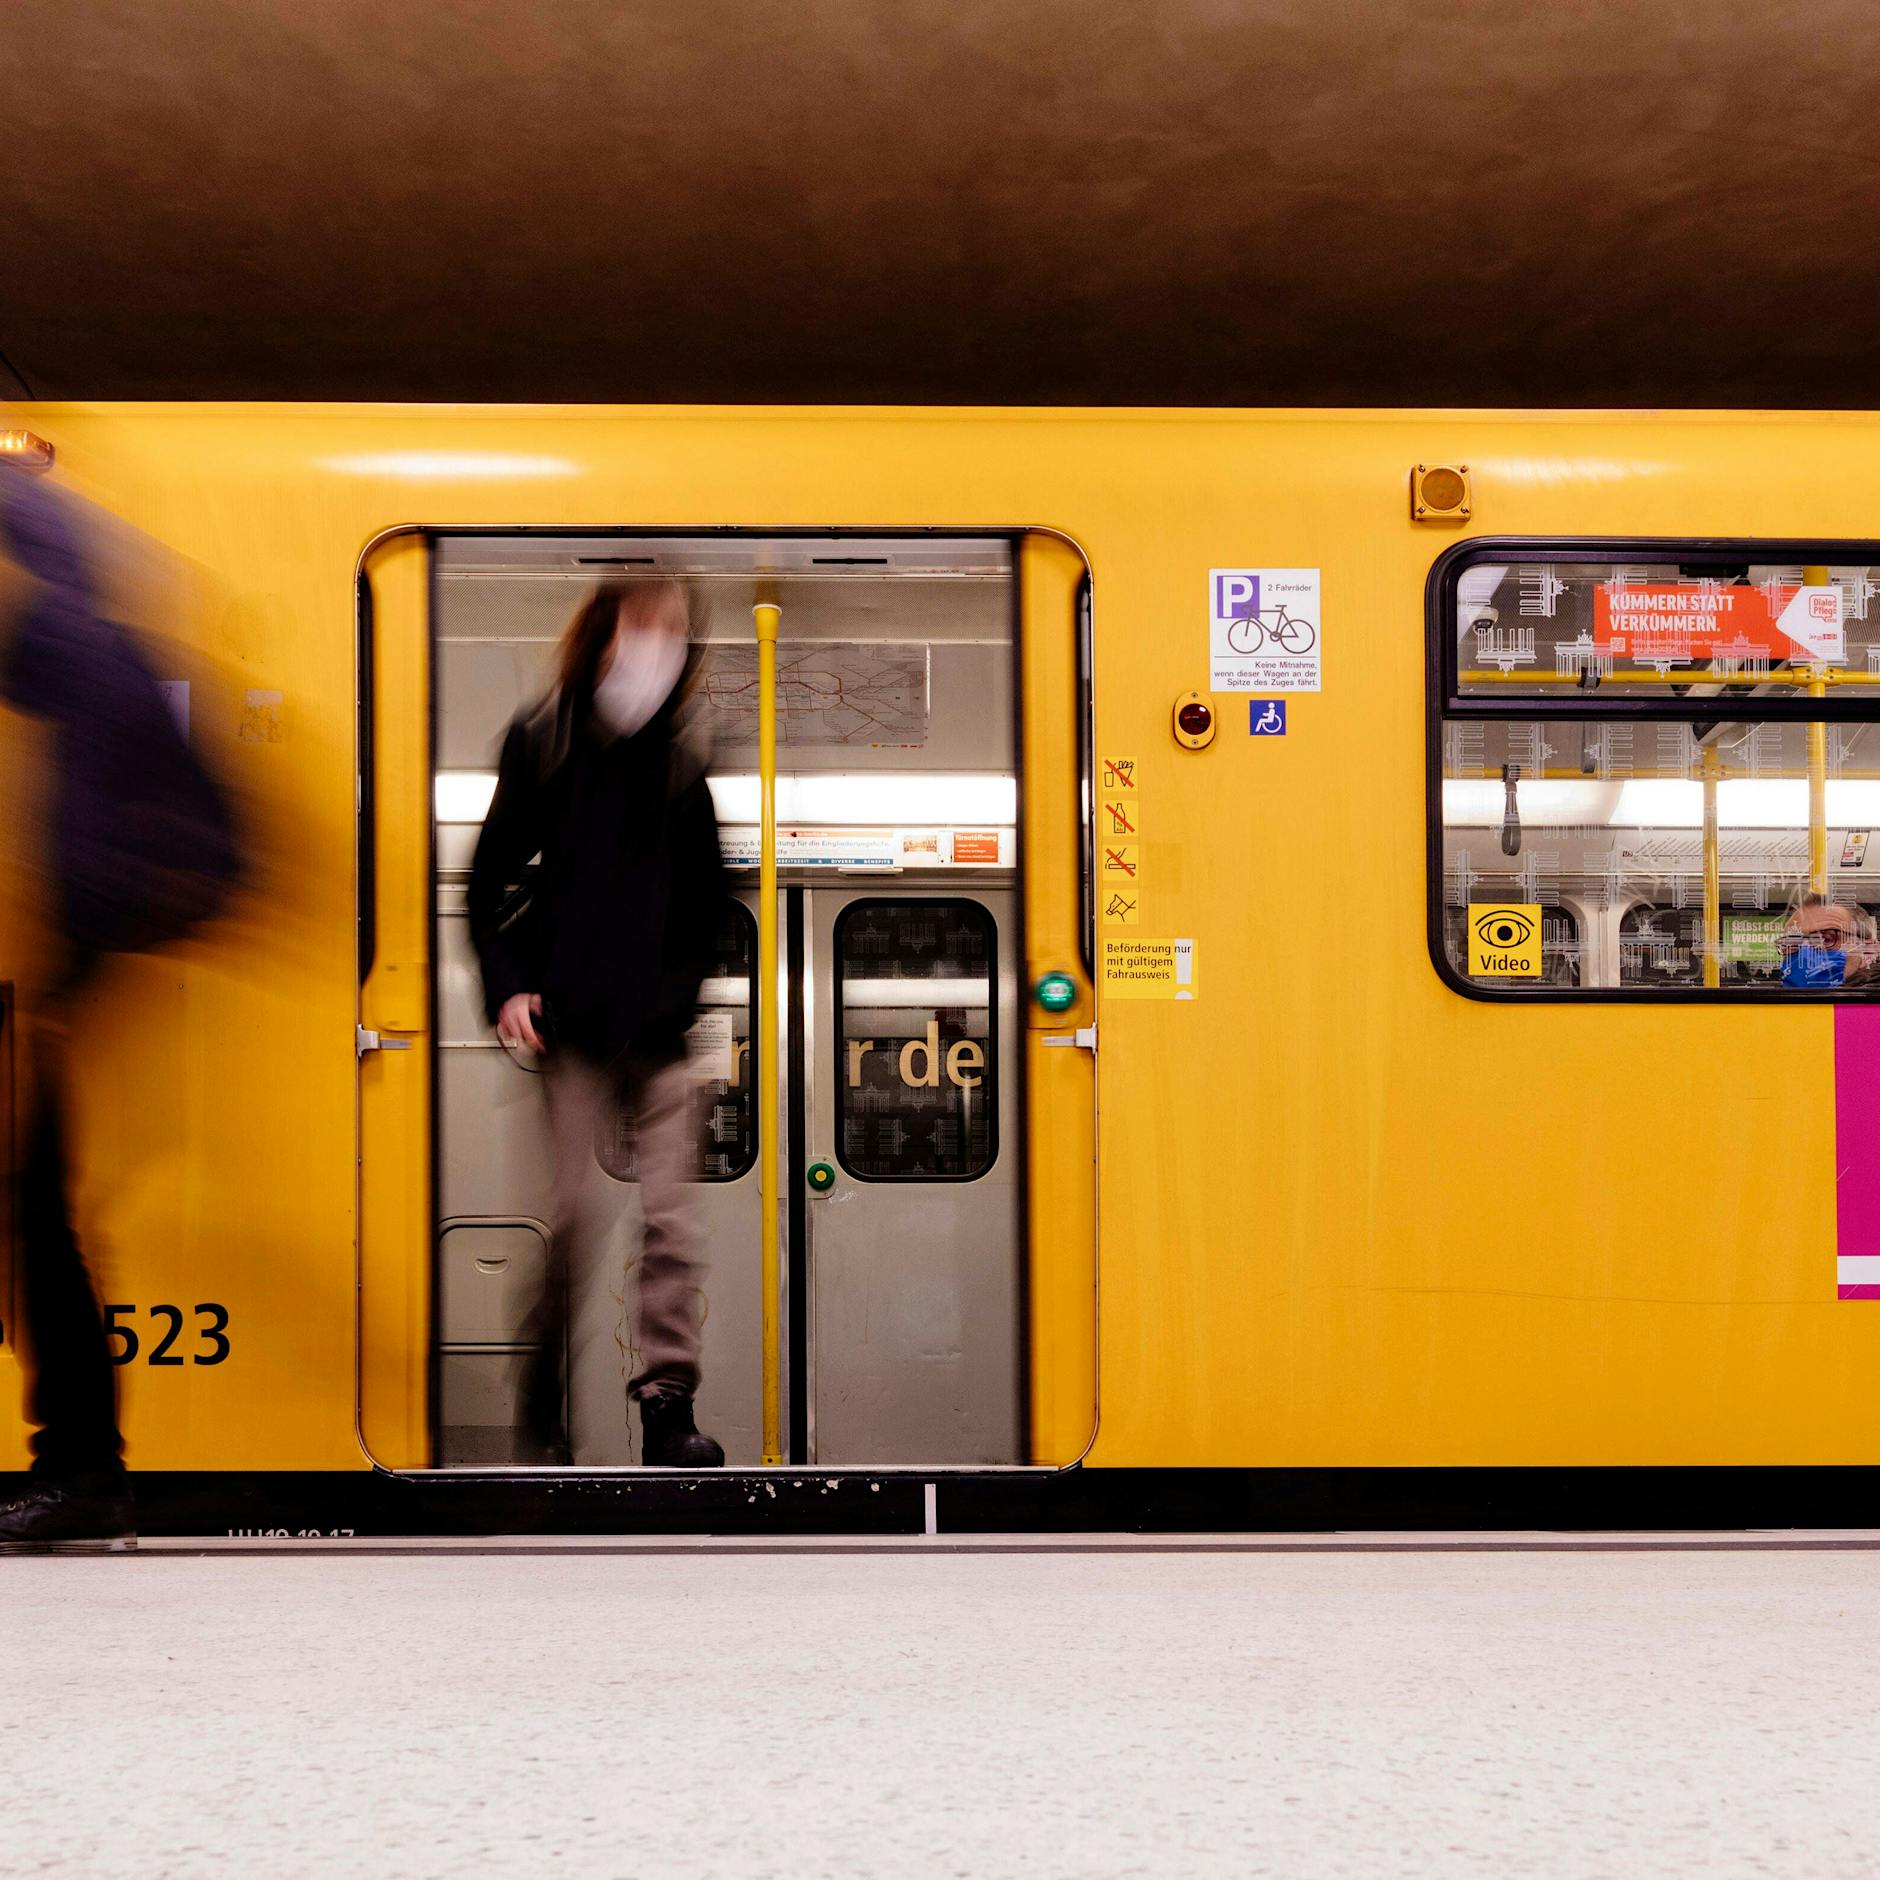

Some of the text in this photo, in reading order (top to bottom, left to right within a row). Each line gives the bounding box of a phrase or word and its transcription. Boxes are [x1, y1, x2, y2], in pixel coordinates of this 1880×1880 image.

[1267, 583, 1312, 592] 2 Fahrräder
[1222, 576, 1254, 618] P
[1690, 594, 1734, 611] STATT
[1609, 613, 1721, 632] VERKÜMMERN.
[1255, 661, 1318, 670] Keine Mitnahme,
[1236, 669, 1260, 677] dieser
[1263, 669, 1290, 679] Wagen
[1304, 669, 1317, 677] der
[1227, 678, 1318, 688] Spitze des Zuges fährt.
[1731, 933, 1768, 943] WERDEN
[1107, 943, 1191, 956] Beförderung nur
[1106, 957, 1173, 969] mit gültigem
[1480, 954, 1530, 971] Video
[1107, 969, 1170, 979] Fahrausweis
